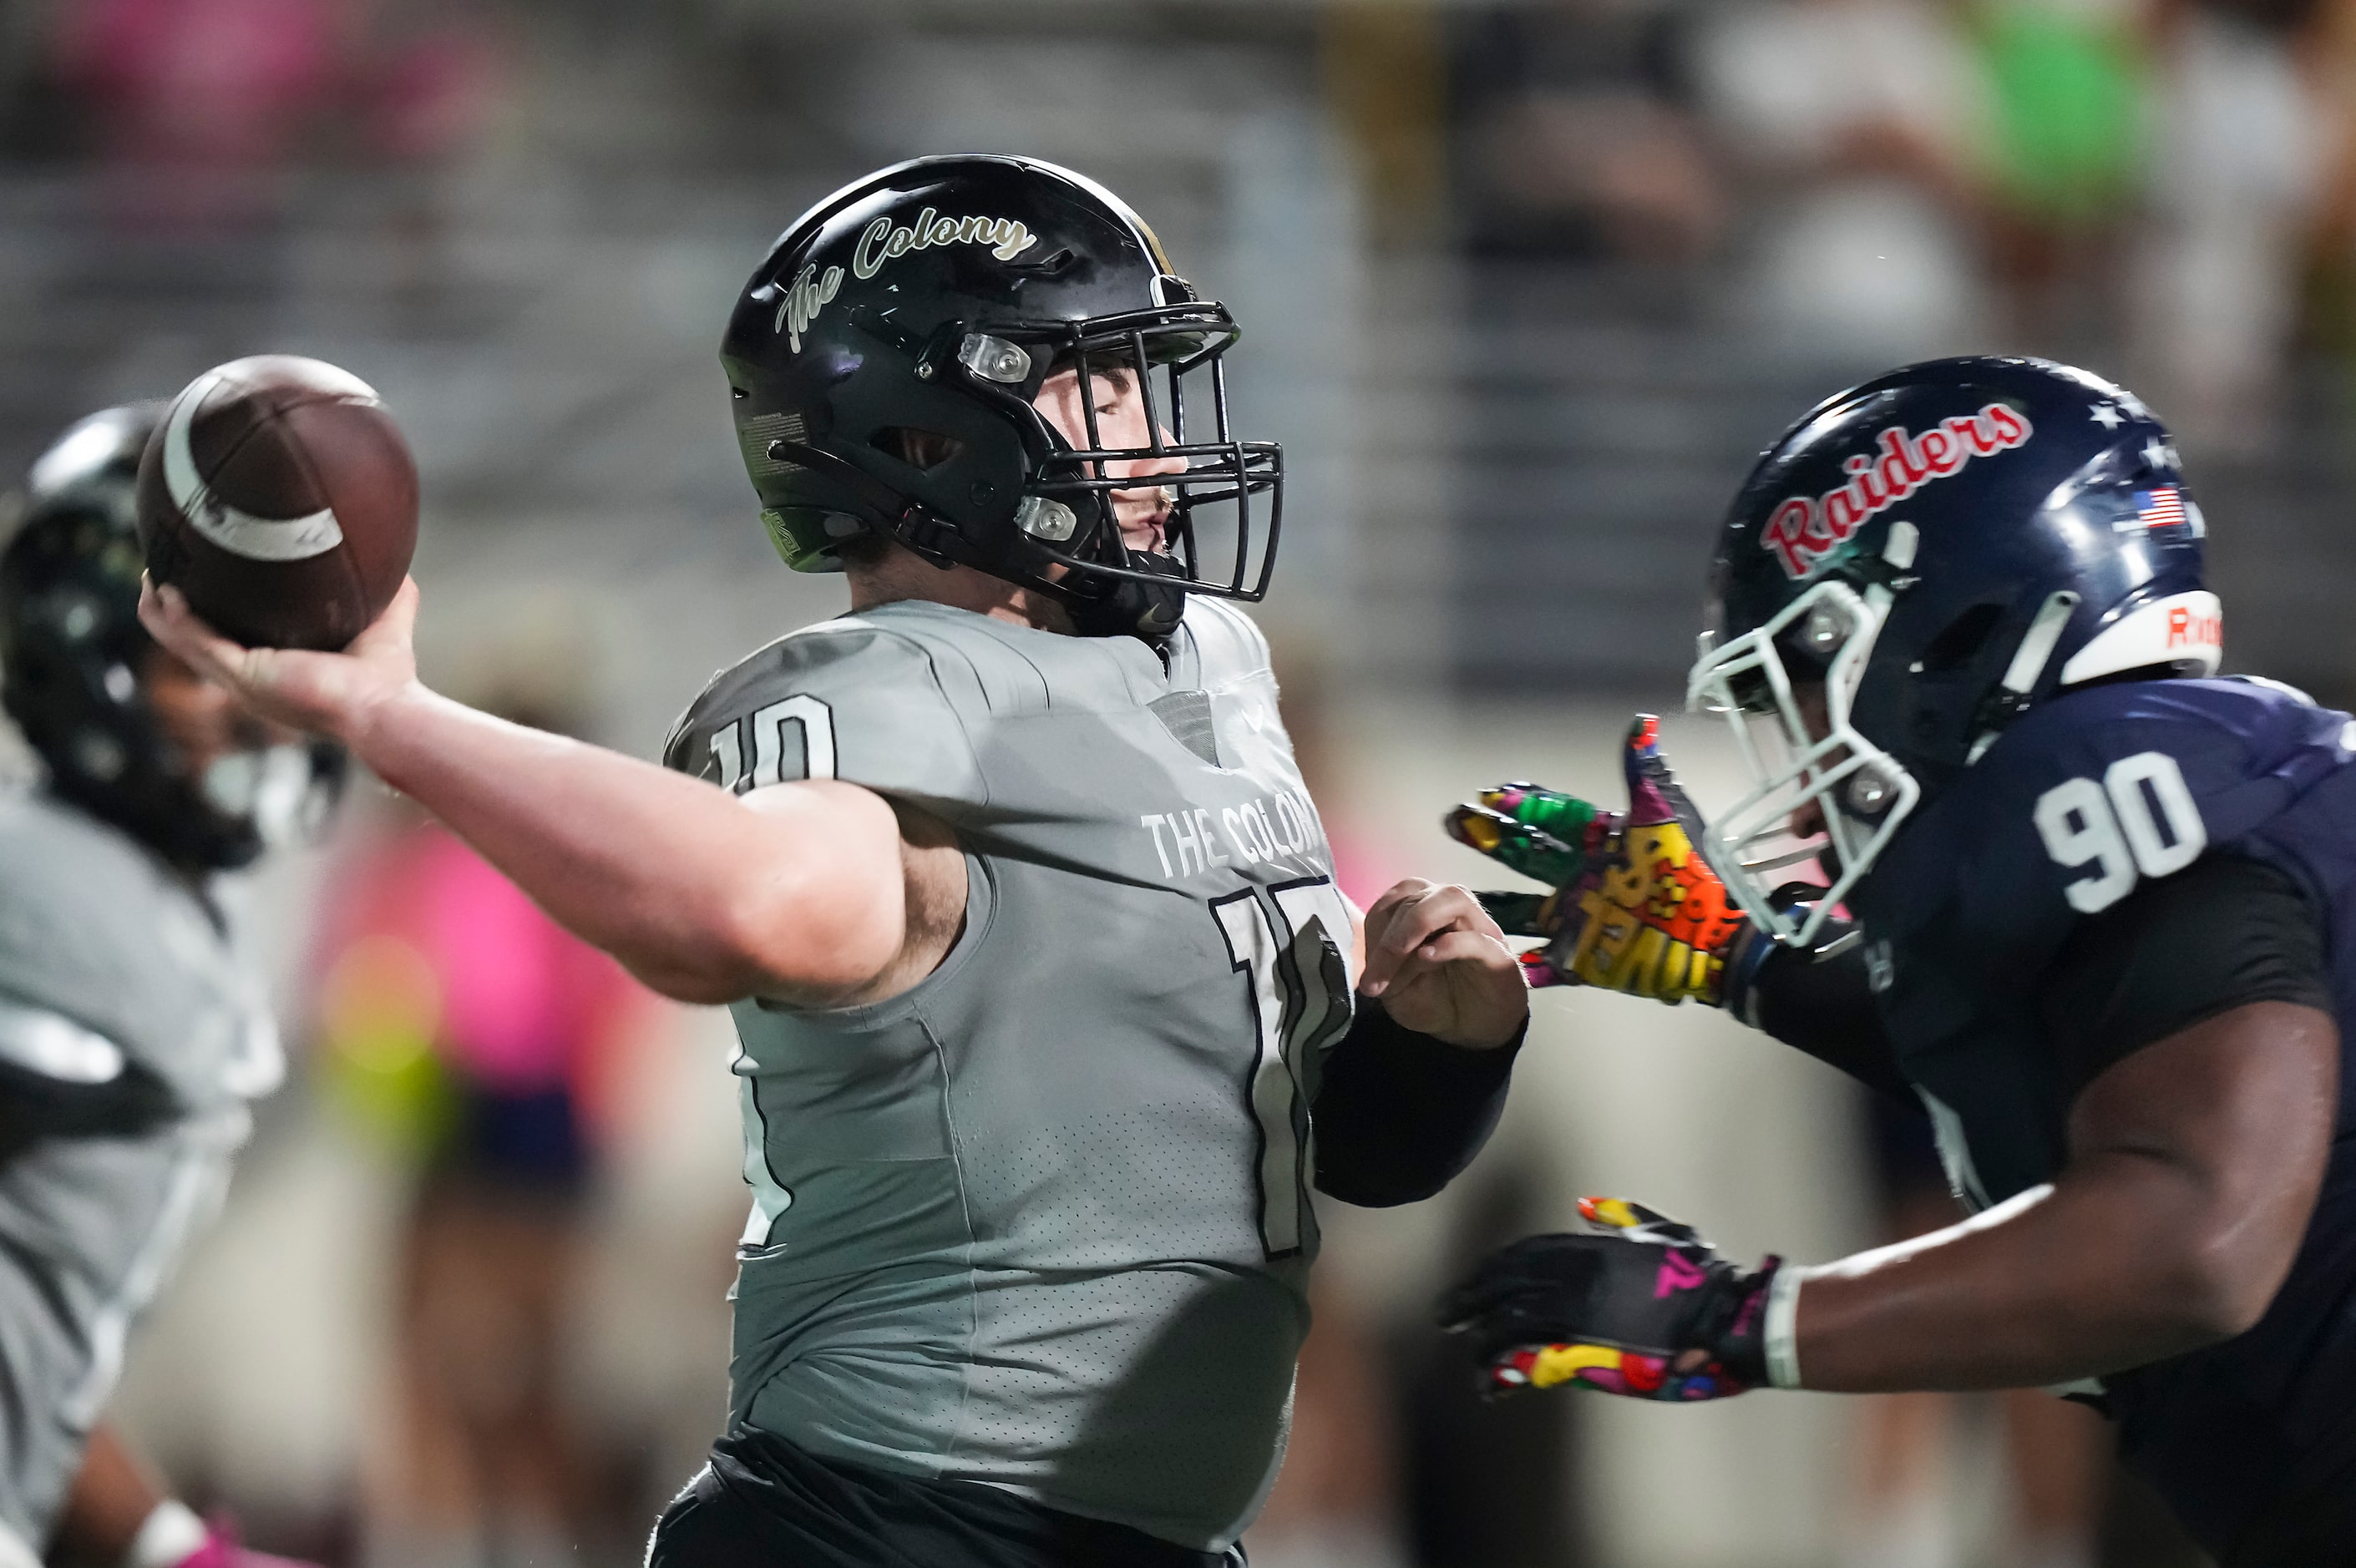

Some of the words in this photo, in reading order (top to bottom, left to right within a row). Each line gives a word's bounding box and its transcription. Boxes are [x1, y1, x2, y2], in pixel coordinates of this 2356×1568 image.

[775, 262, 845, 354] The
[853, 207, 1037, 280] Colony
[1760, 402, 2034, 580] Raiders
[1141, 808, 1229, 878] THE
[2033, 751, 2207, 914] 90
